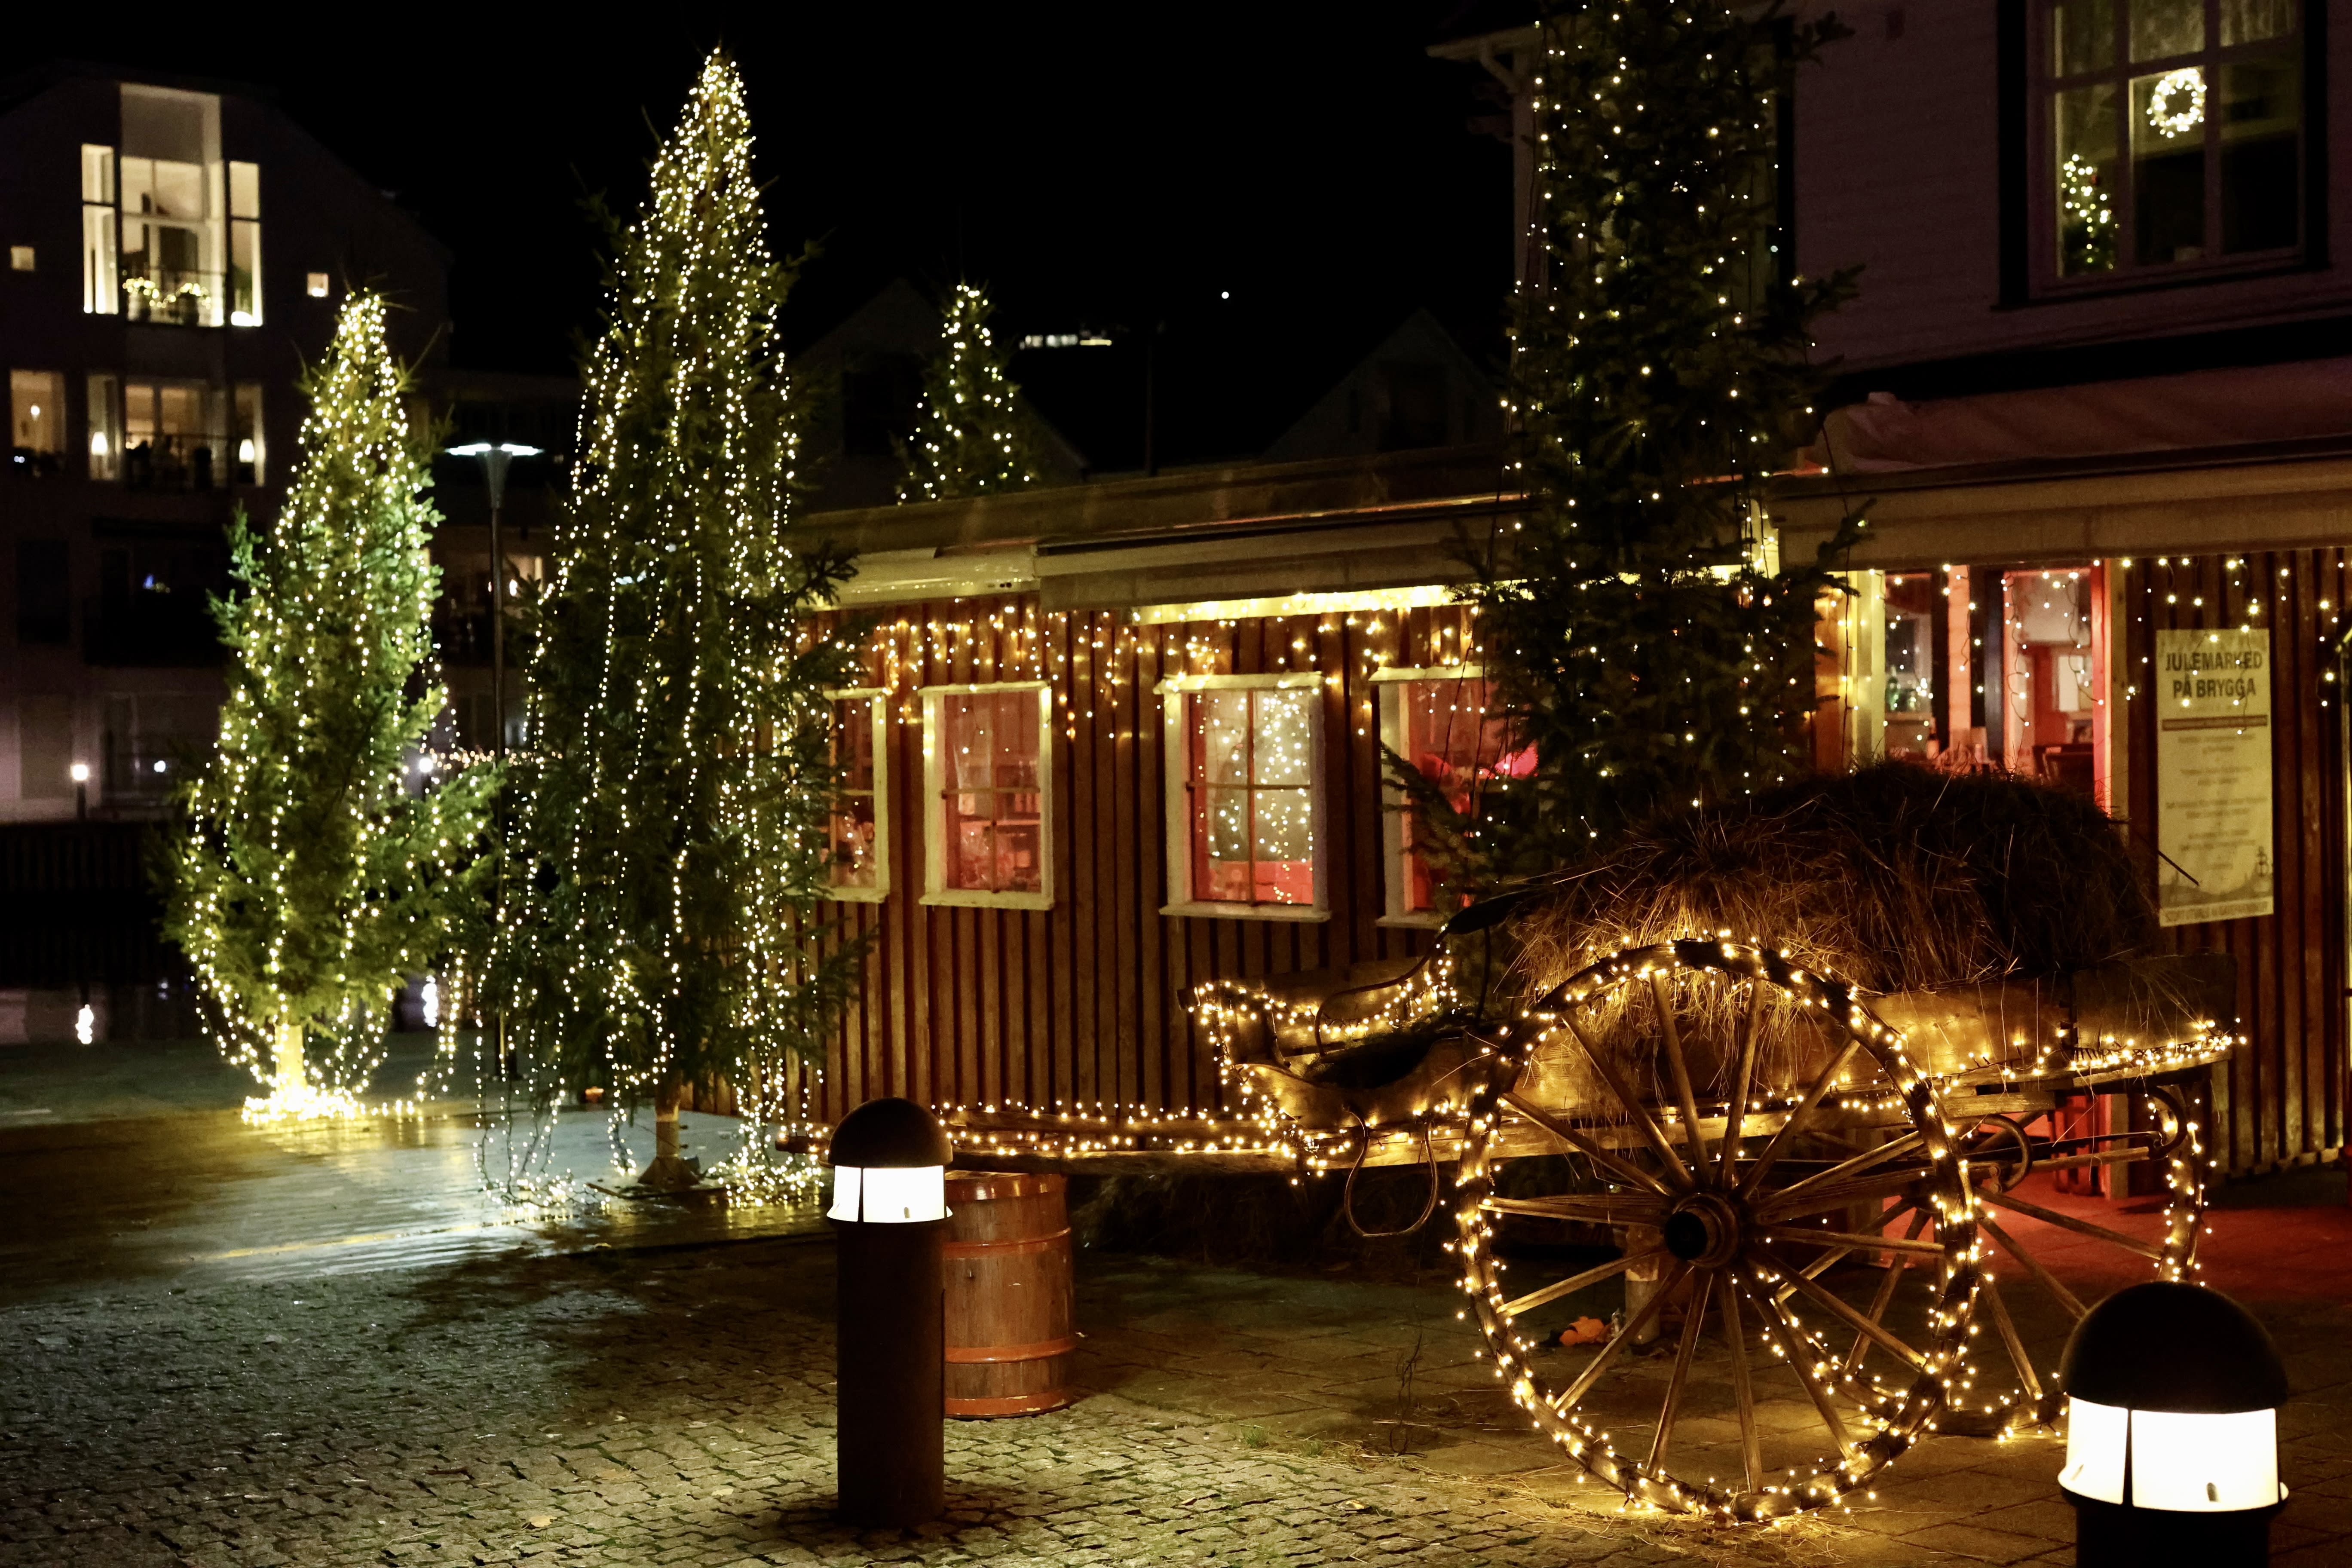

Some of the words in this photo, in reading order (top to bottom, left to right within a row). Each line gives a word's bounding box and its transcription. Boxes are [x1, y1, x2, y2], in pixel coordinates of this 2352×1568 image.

[2165, 651, 2262, 671] JULEMARKED
[2173, 673, 2192, 698] PÅ
[2196, 678, 2256, 698] BRYGGA
